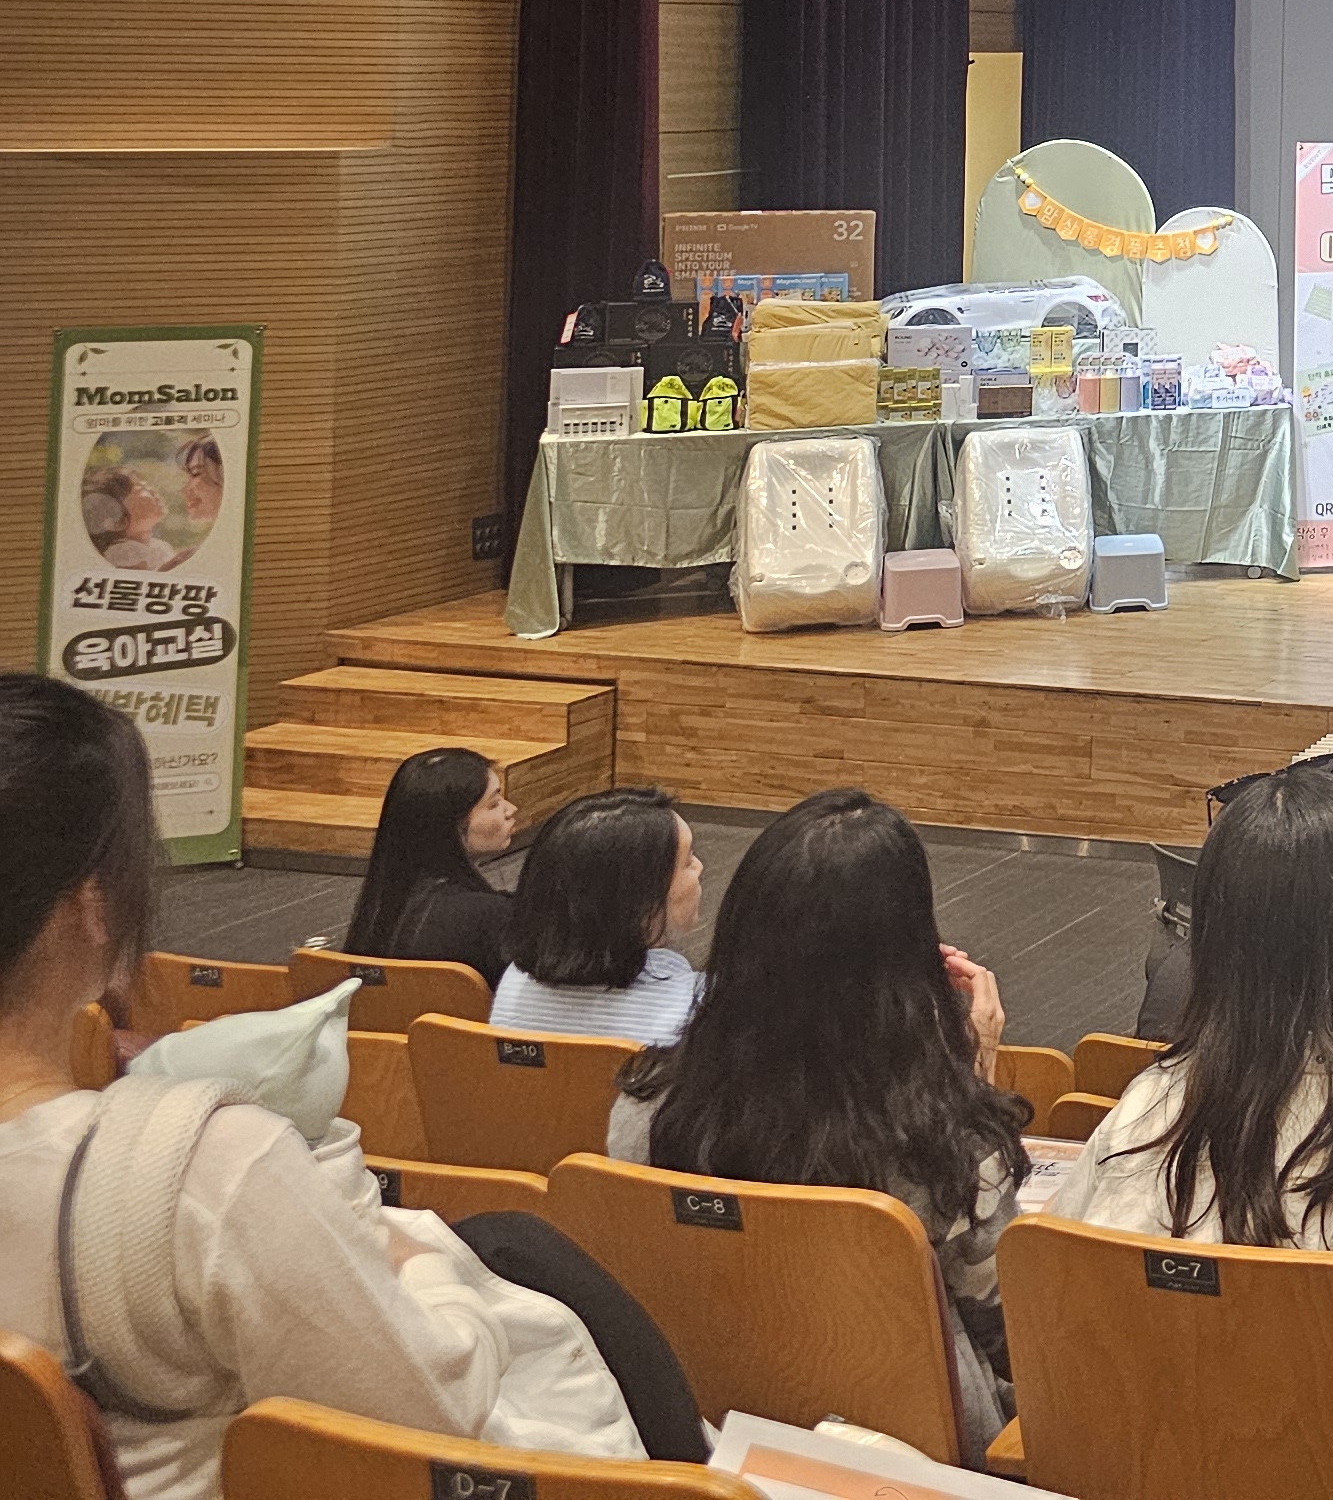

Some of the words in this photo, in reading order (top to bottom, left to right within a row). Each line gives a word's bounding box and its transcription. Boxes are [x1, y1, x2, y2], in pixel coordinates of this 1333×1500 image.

[832, 219, 865, 242] 32
[674, 242, 722, 252] INFINITE
[674, 251, 733, 261] SPECTRUM
[674, 261, 699, 270] INTO
[701, 260, 731, 269] YOUR
[674, 270, 714, 280] SMART
[74, 383, 240, 407] MomSalon
[190, 412, 227, 425] 세미나
[1315, 503, 1333, 517] QR
[1320, 526, 1329, 538] 후
[71, 577, 219, 618] 선물팡팡
[75, 622, 225, 671] 육아교실
[192, 967, 220, 980] A-13
[503, 1042, 538, 1057] B-10
[687, 1195, 725, 1214] C-8
[1162, 1258, 1201, 1279] C-7
[456, 1471, 512, 1500] D-7
